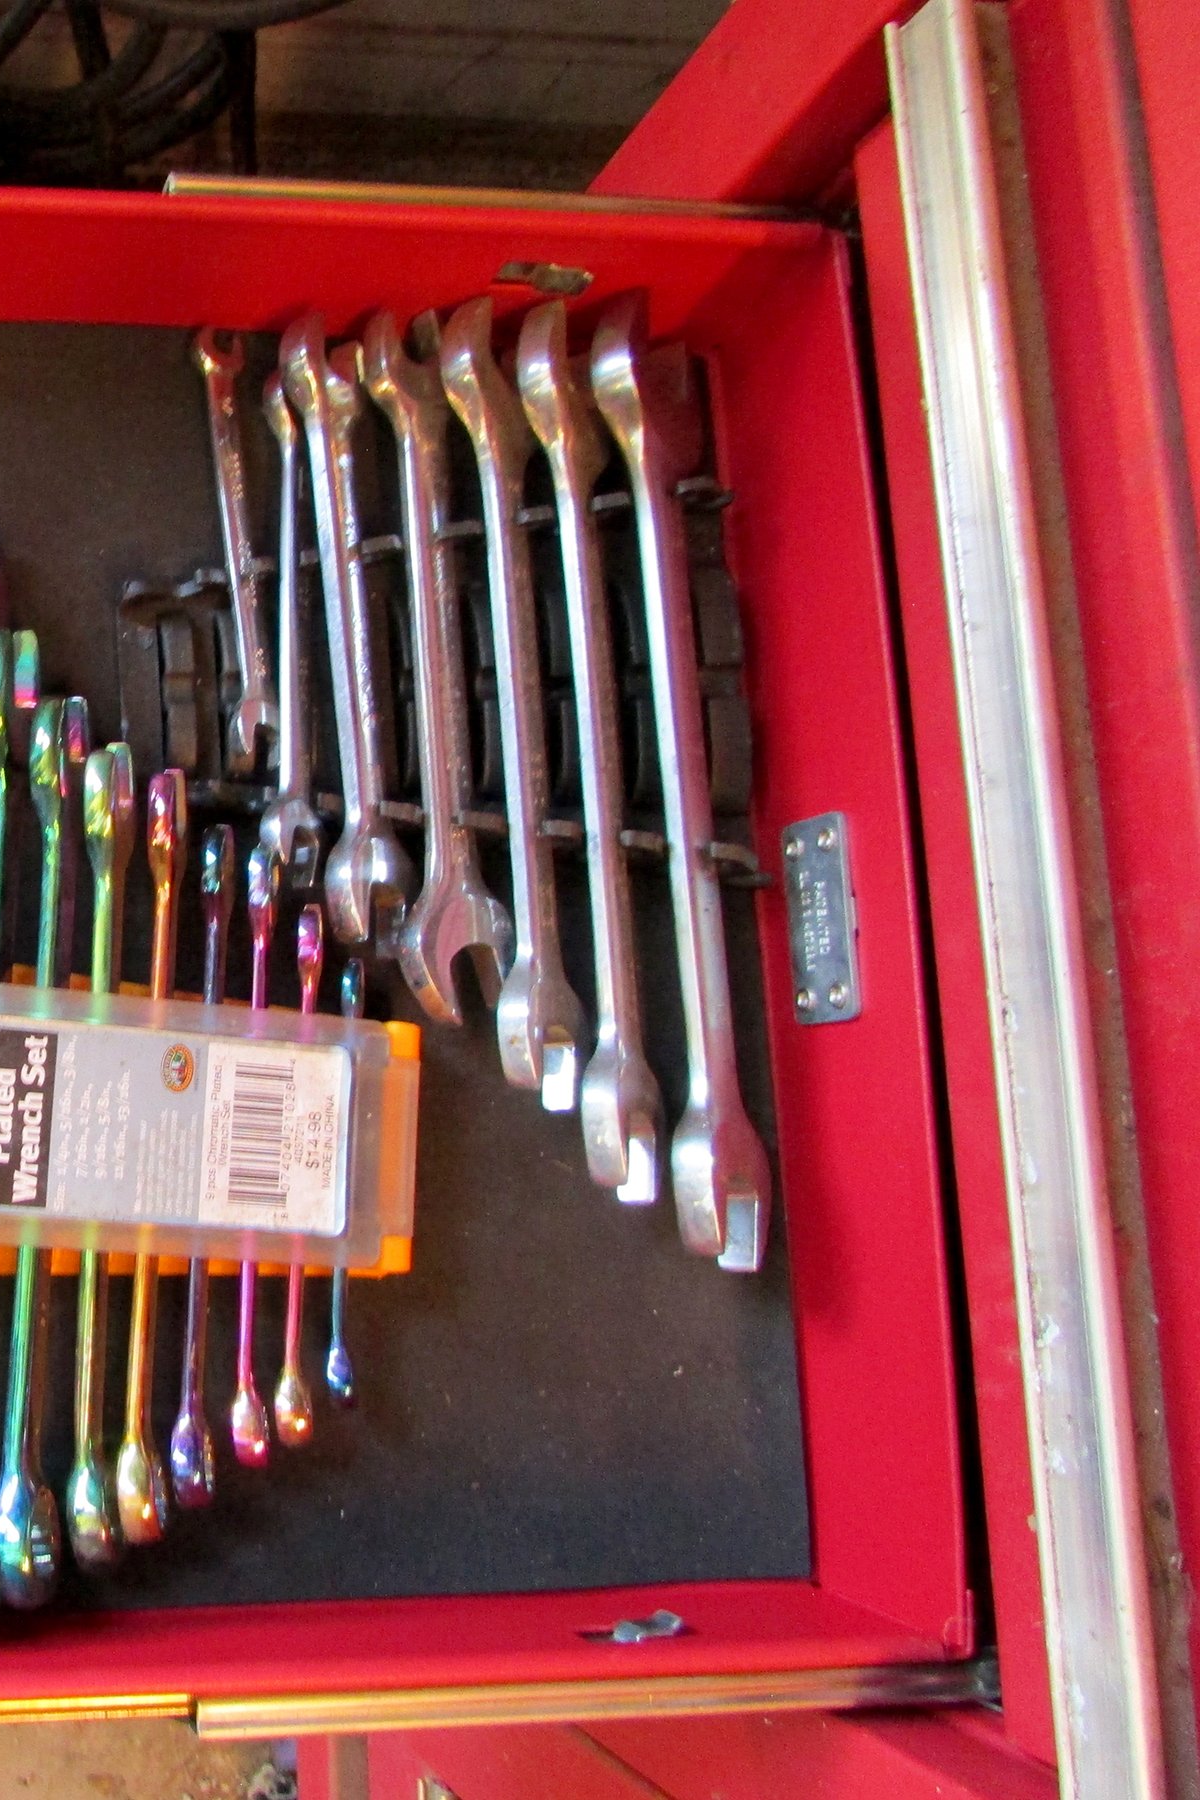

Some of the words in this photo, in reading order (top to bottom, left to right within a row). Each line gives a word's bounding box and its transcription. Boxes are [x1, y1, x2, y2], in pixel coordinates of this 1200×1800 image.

[20, 1035, 47, 1086] Set
[210, 1064, 222, 1101] Plated
[220, 1099, 231, 1119] Set
[323, 1093, 334, 1132] CHINA
[12, 1092, 44, 1203] Wrench
[207, 1103, 220, 1165] Chromatic
[217, 1122, 229, 1166] Wrench
[321, 1152, 332, 1188] MADE
